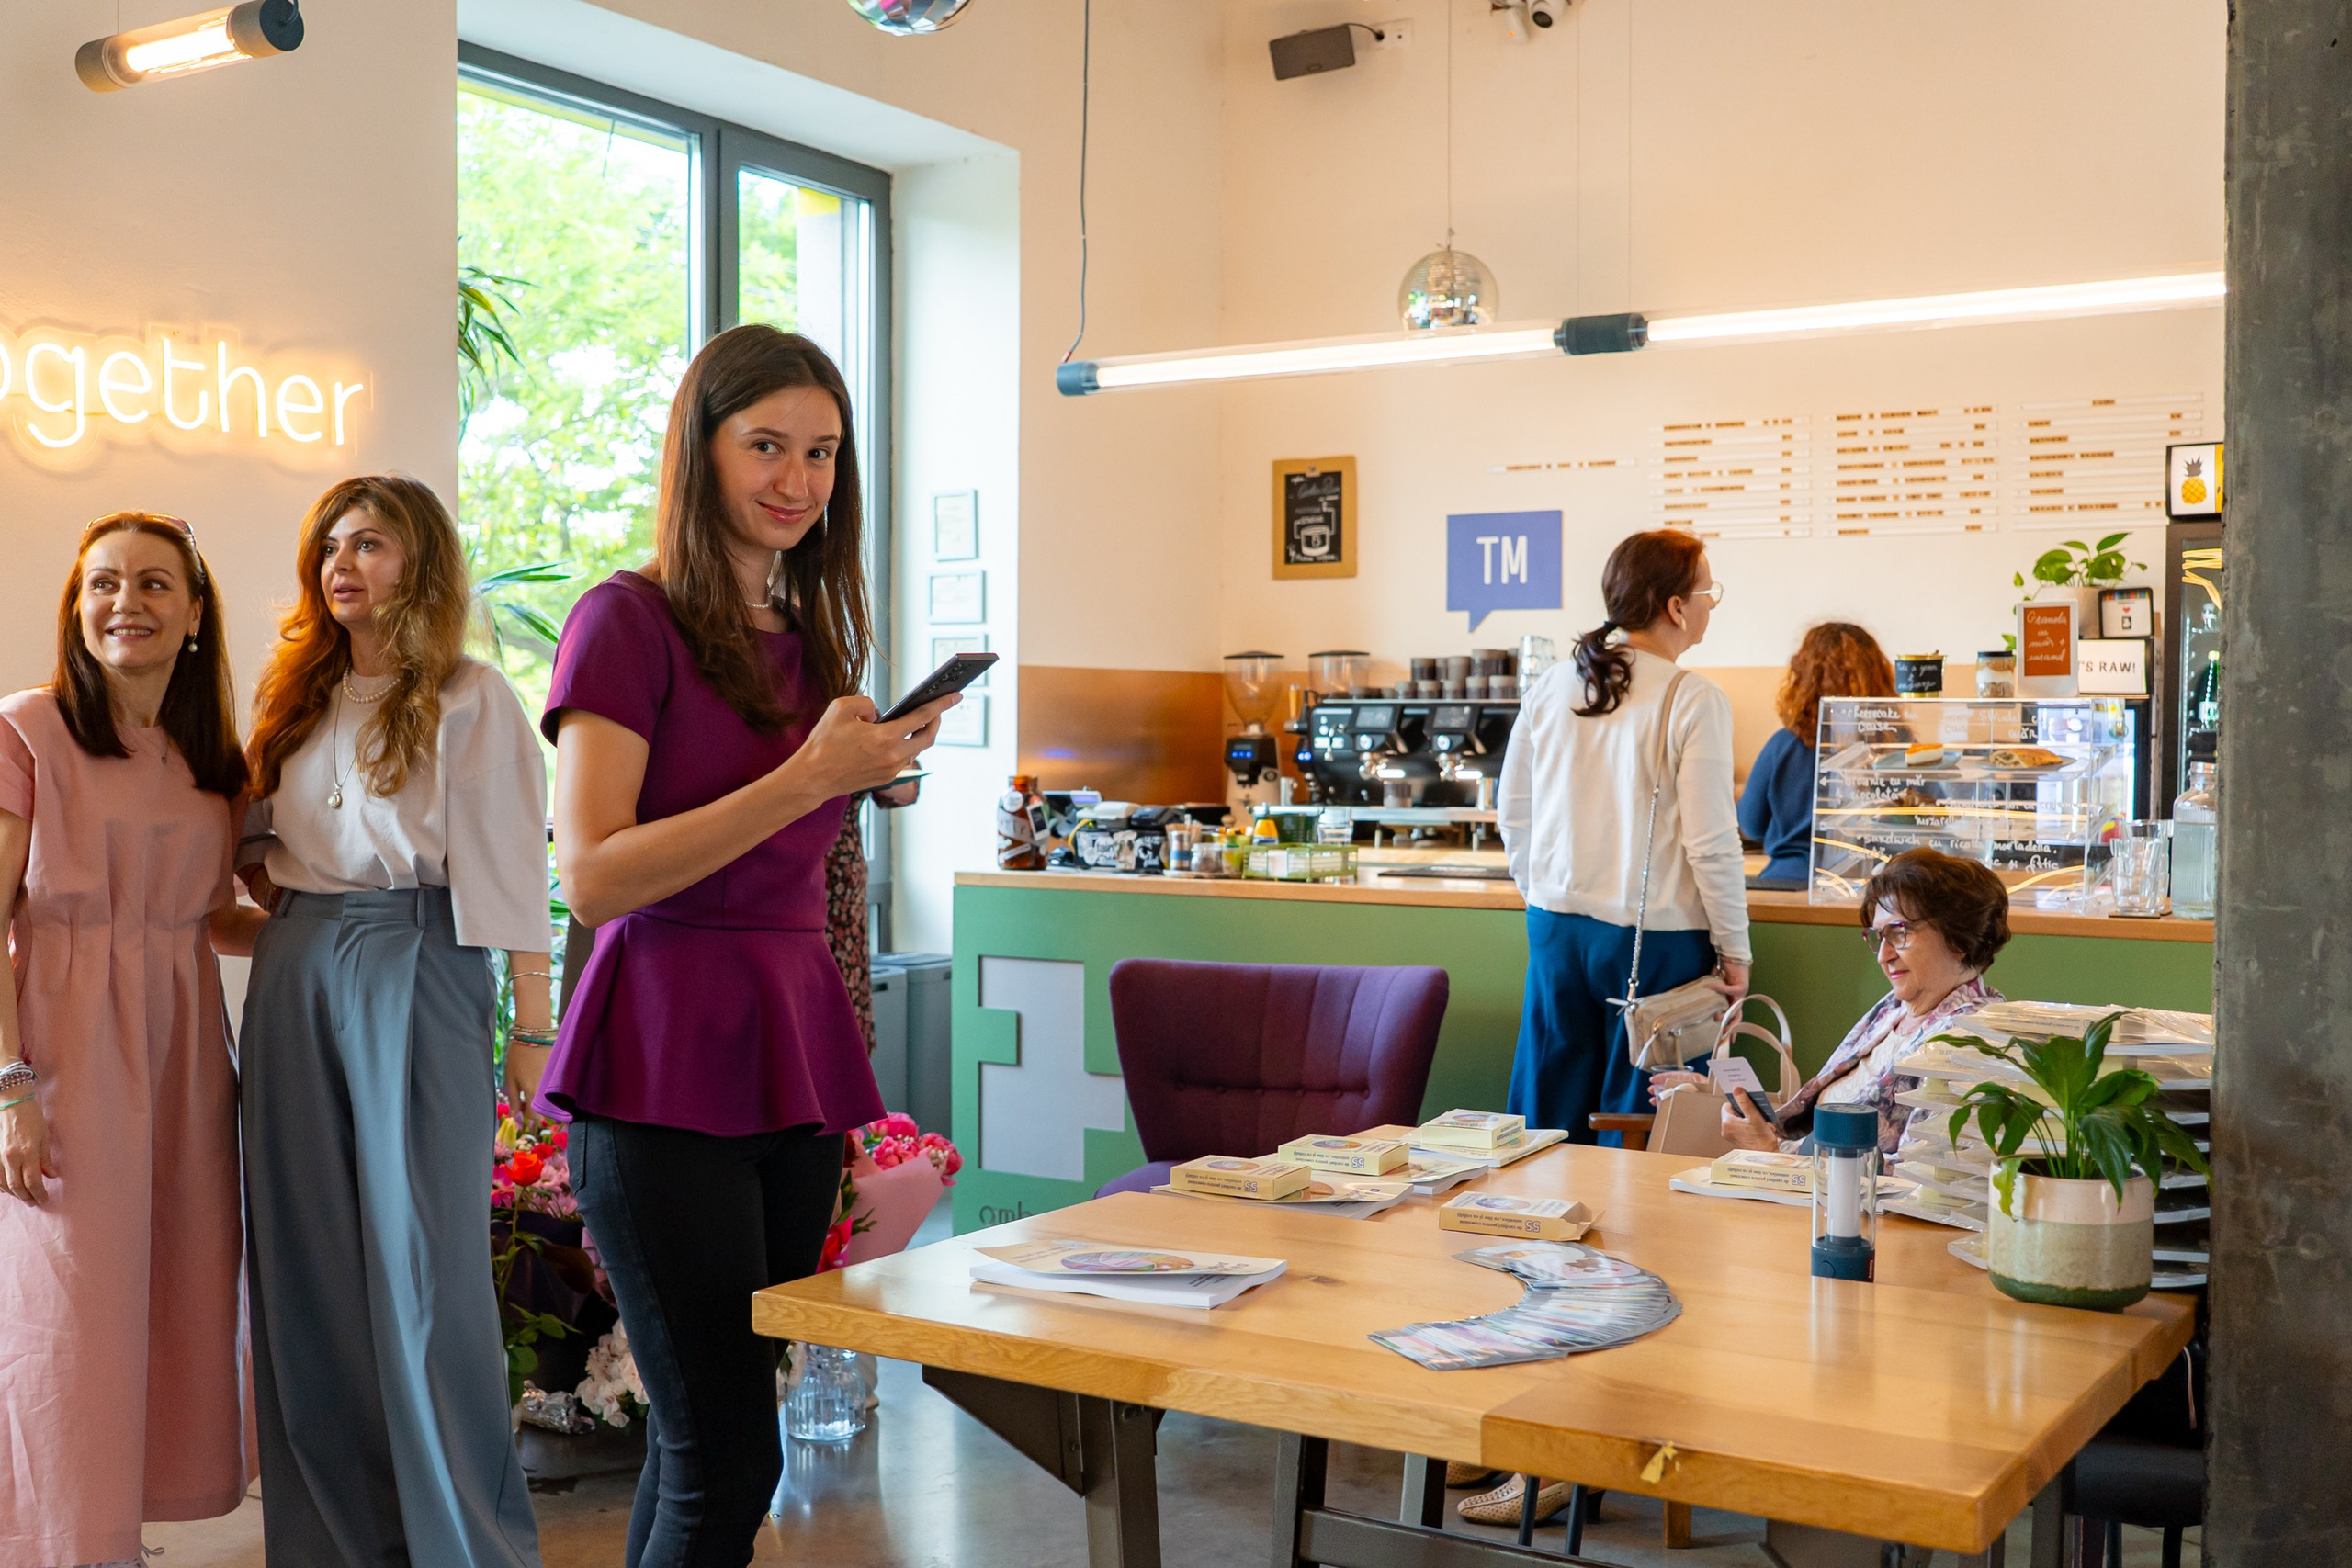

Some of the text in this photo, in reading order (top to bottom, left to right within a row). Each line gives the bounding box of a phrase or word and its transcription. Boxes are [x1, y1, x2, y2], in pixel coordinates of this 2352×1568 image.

[0, 338, 365, 448] gether
[1476, 535, 1528, 586] TM
[2099, 660, 2136, 673] RAW!
[1351, 1156, 1365, 1168] 55
[1243, 1179, 1258, 1193] 55
[1791, 1173, 1806, 1186] 55
[1525, 1219, 1541, 1233] 55
